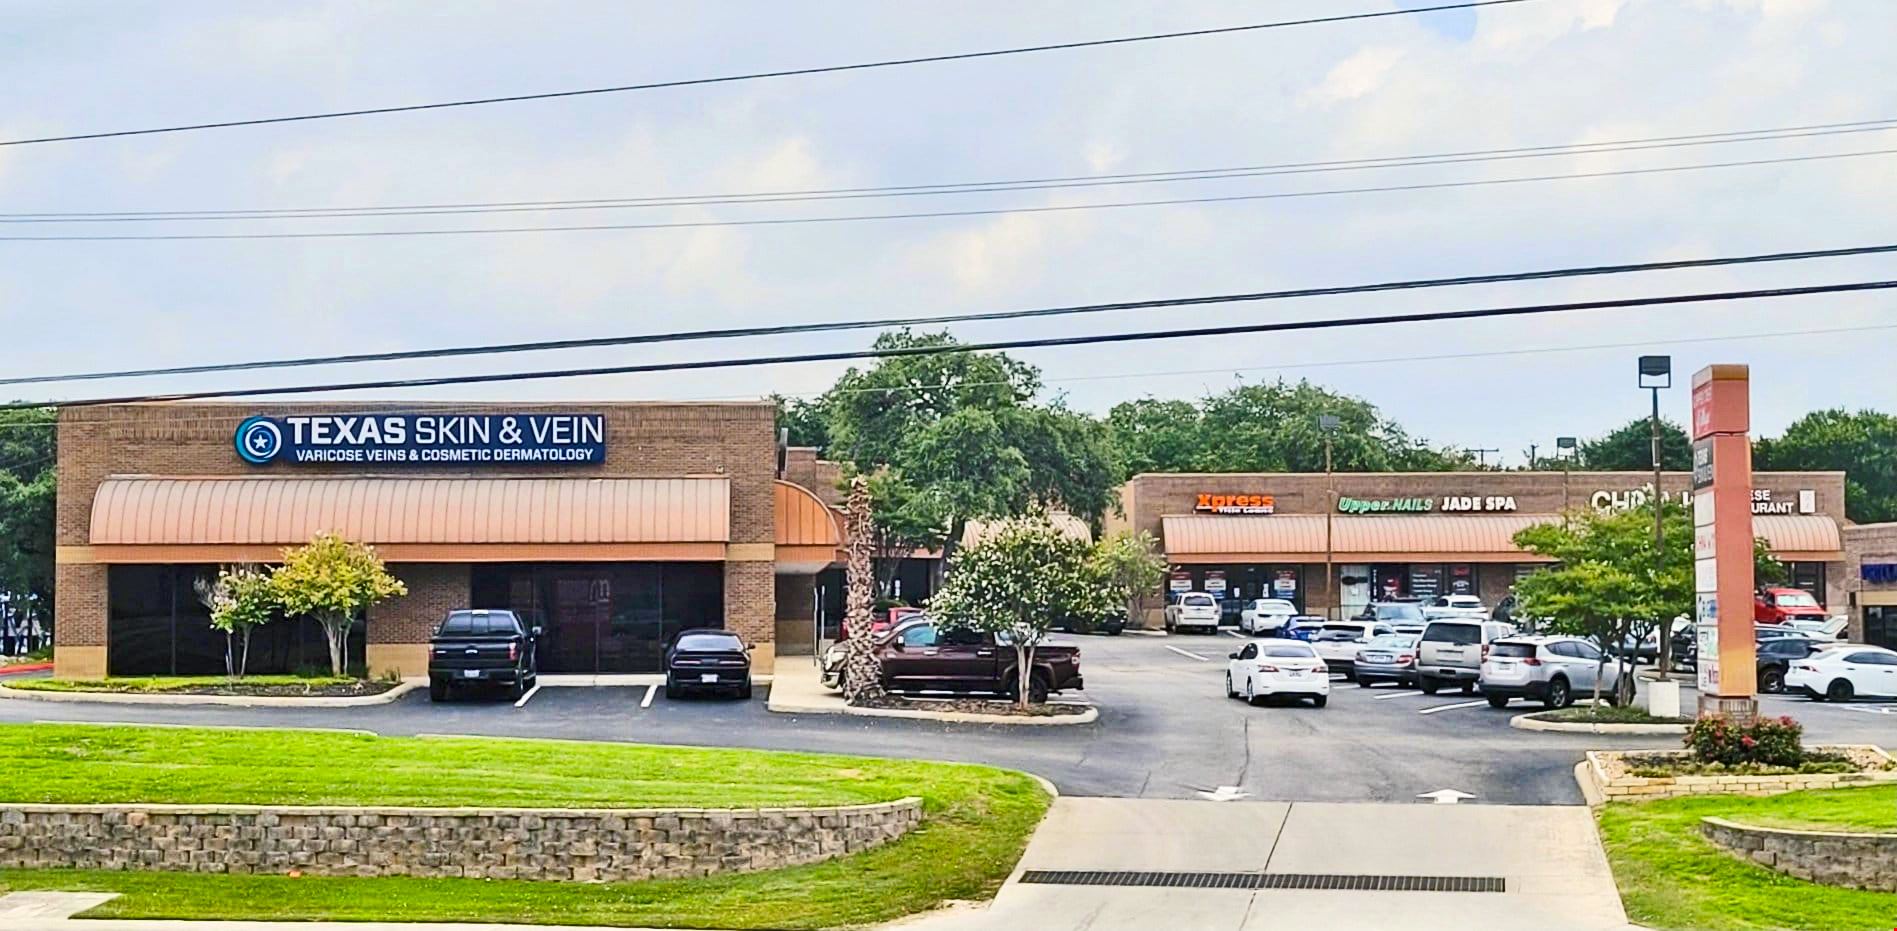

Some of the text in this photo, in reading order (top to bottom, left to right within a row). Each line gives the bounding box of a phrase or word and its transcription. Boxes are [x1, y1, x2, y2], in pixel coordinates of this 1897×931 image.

[287, 417, 603, 444] TEXAS SKIN & VEIN
[296, 448, 594, 461] VARICOSE VEINS & COSMETIC DERMATOLOGY
[1196, 494, 1275, 512] Xpress
[1393, 498, 1434, 511] NAILS
[1441, 497, 1517, 511] JADE SPA
